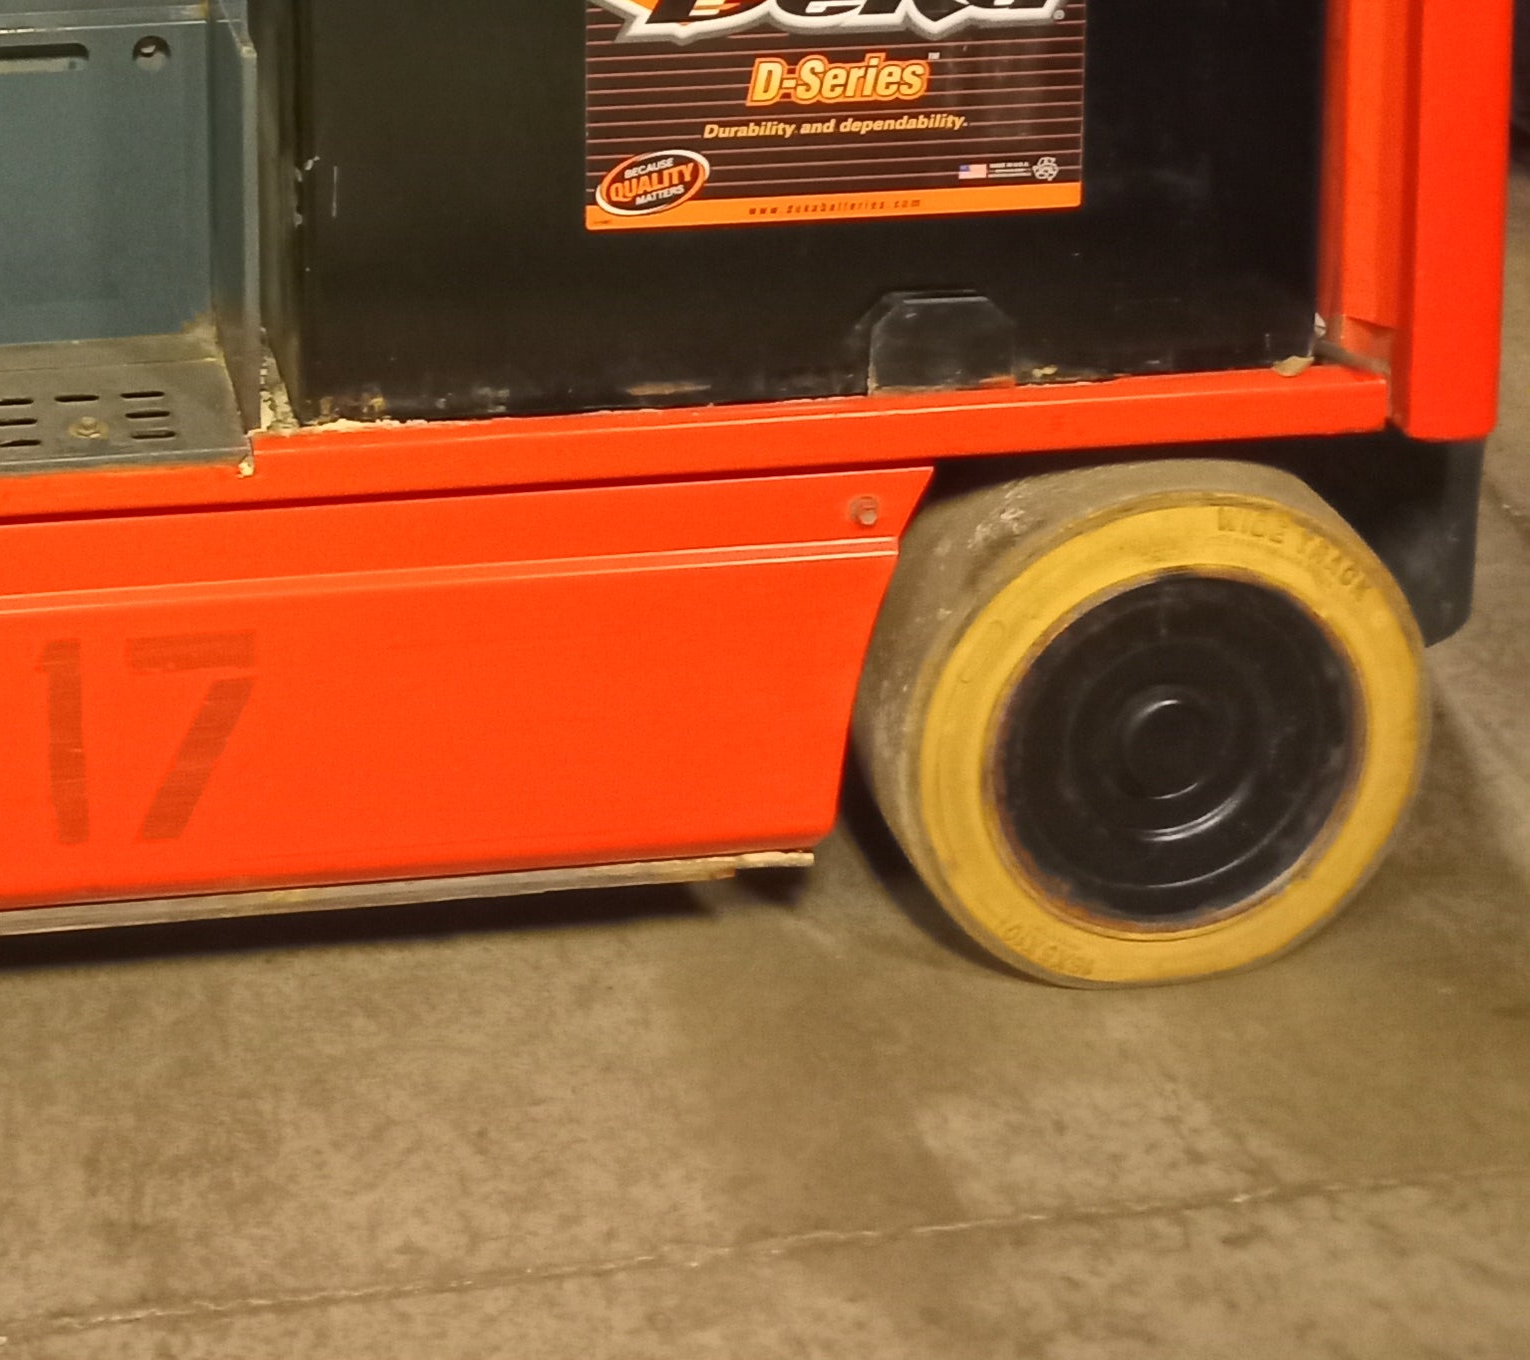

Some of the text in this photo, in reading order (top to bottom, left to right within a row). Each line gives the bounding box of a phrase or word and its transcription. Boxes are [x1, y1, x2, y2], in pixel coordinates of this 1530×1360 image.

[748, 54, 930, 105] D-Series
[703, 120, 796, 139] Durability
[800, 117, 835, 135] and
[609, 162, 695, 202] QUALITY
[624, 157, 675, 179] BECAUSE
[635, 184, 685, 206] MATTERS
[36, 630, 258, 845] 17
